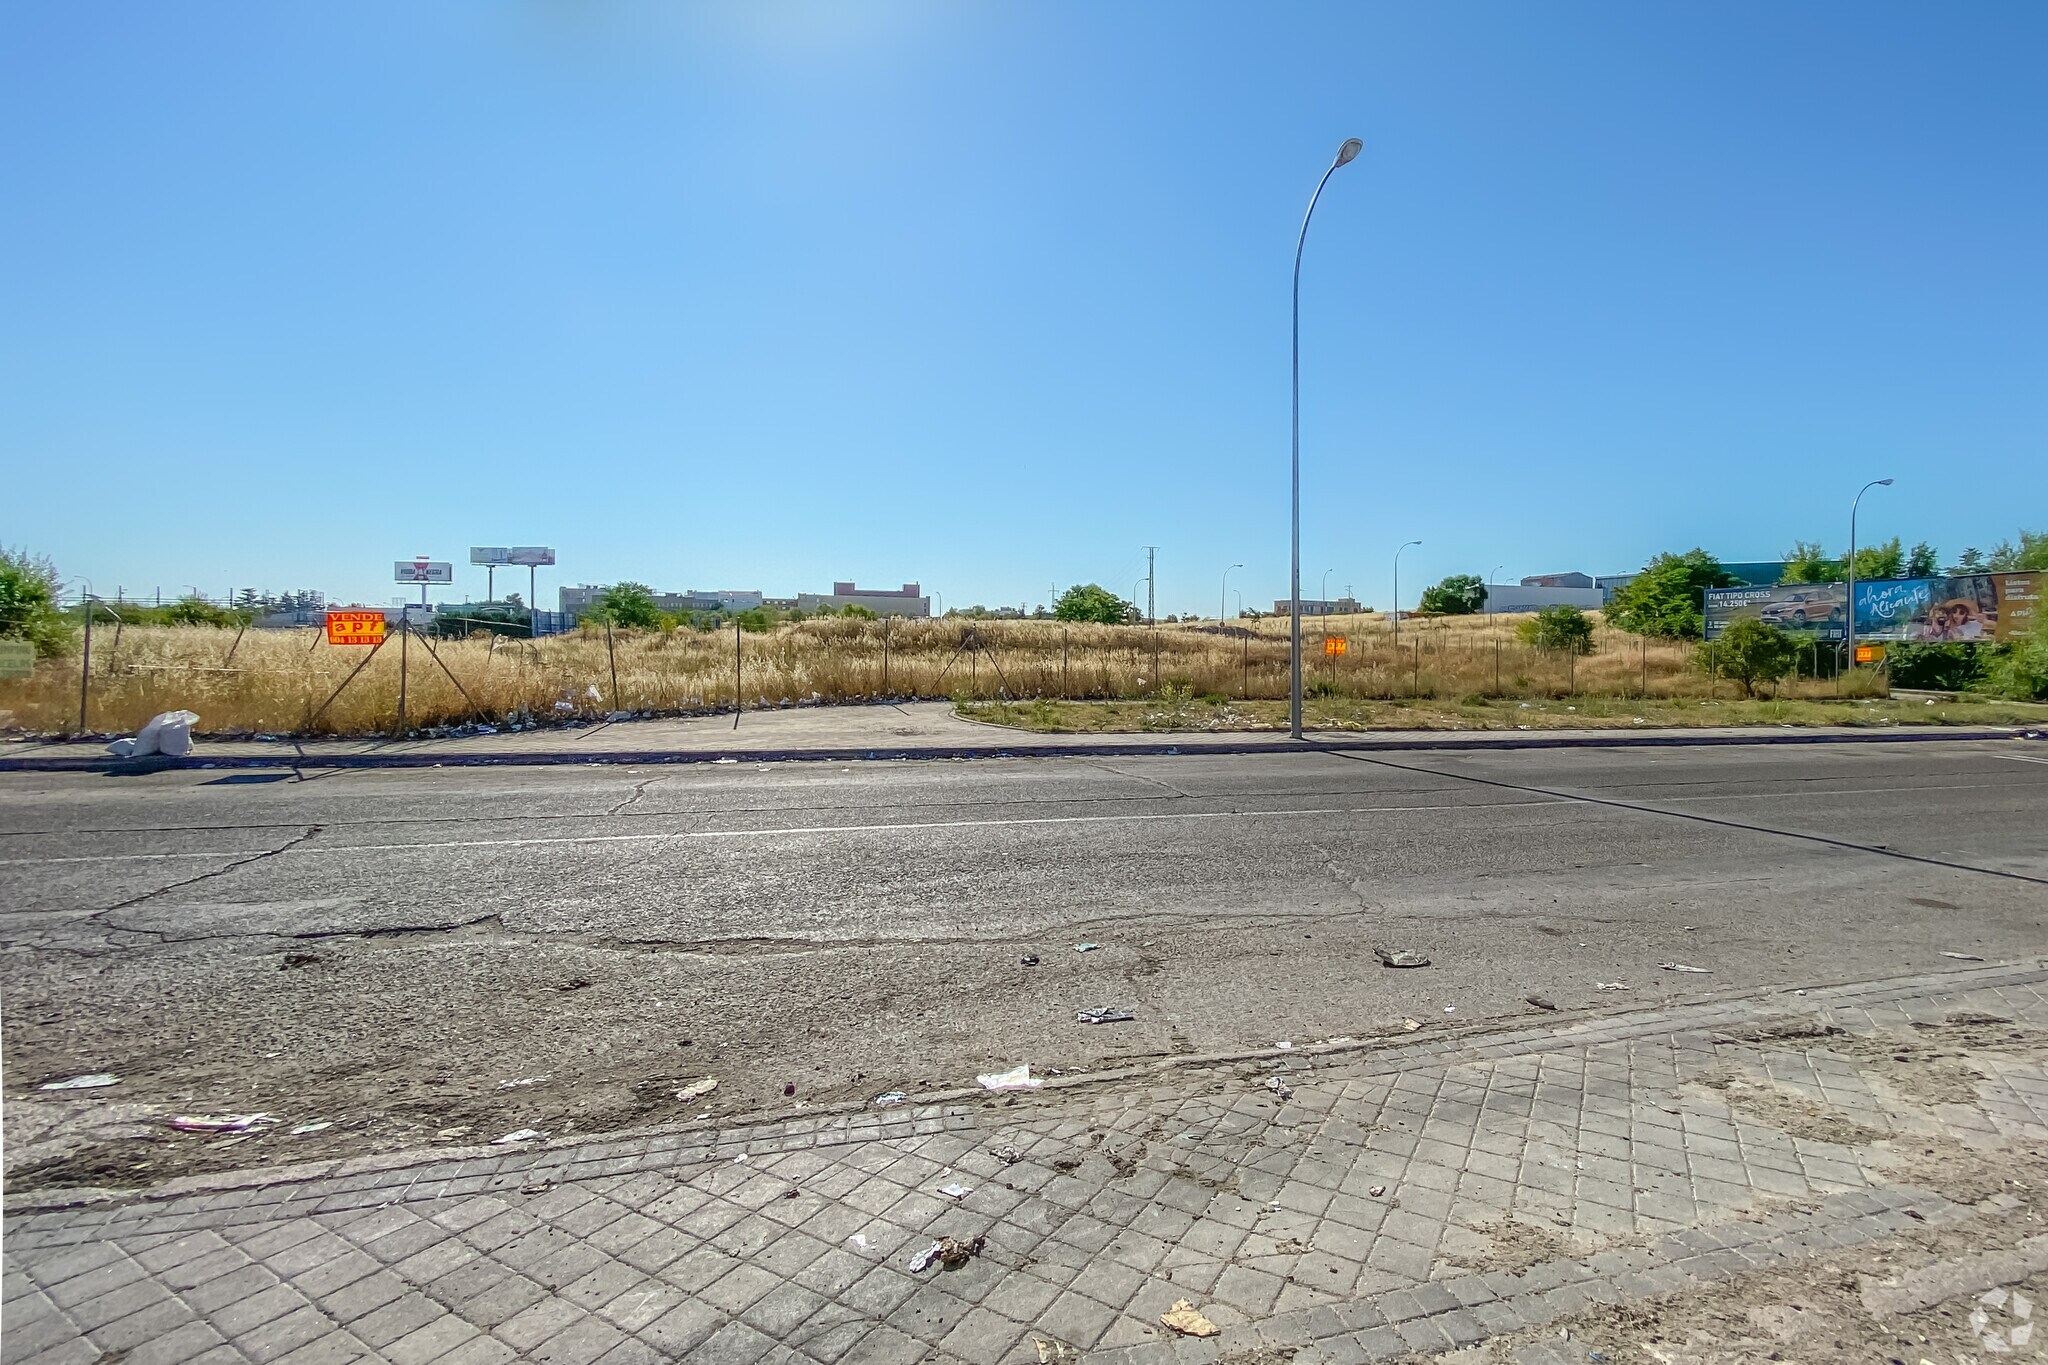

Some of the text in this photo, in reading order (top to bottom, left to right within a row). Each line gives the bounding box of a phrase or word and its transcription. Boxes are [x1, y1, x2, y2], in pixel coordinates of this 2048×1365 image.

[1708, 591, 1771, 600] FIAT TIPO CROSS
[330, 613, 383, 621] VENDE
[348, 636, 358, 644] 13
